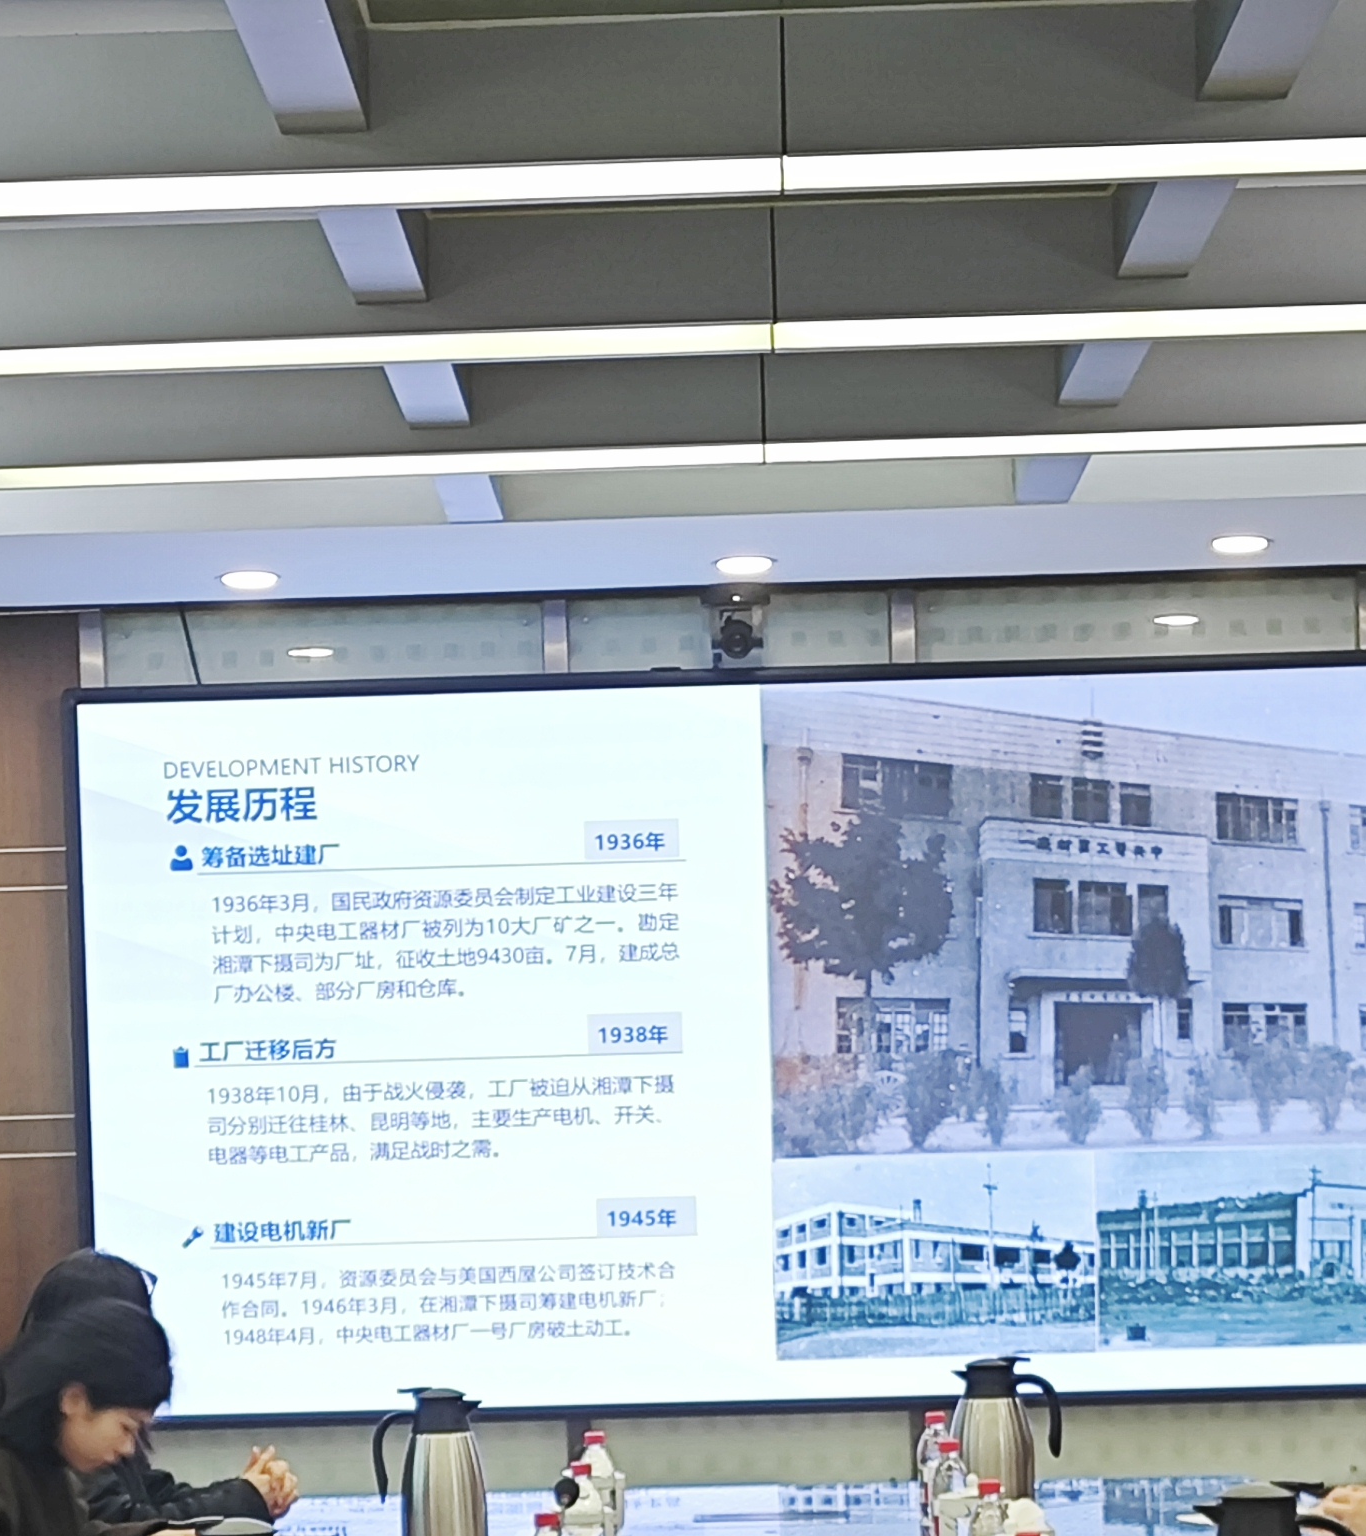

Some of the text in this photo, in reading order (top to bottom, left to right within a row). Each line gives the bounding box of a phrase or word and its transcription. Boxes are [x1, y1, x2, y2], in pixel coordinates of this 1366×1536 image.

[163, 754, 420, 780] DEVELOPMENT HISTORY
[165, 786, 318, 825] 发展历程
[593, 832, 666, 853] 1936年
[201, 843, 340, 869] 筹备选址建厂
[597, 1024, 669, 1045] 1938年
[198, 1038, 337, 1063] 工厂迁移后方
[606, 1207, 677, 1228] 1945年
[213, 1219, 353, 1246] 建设电机新厂
